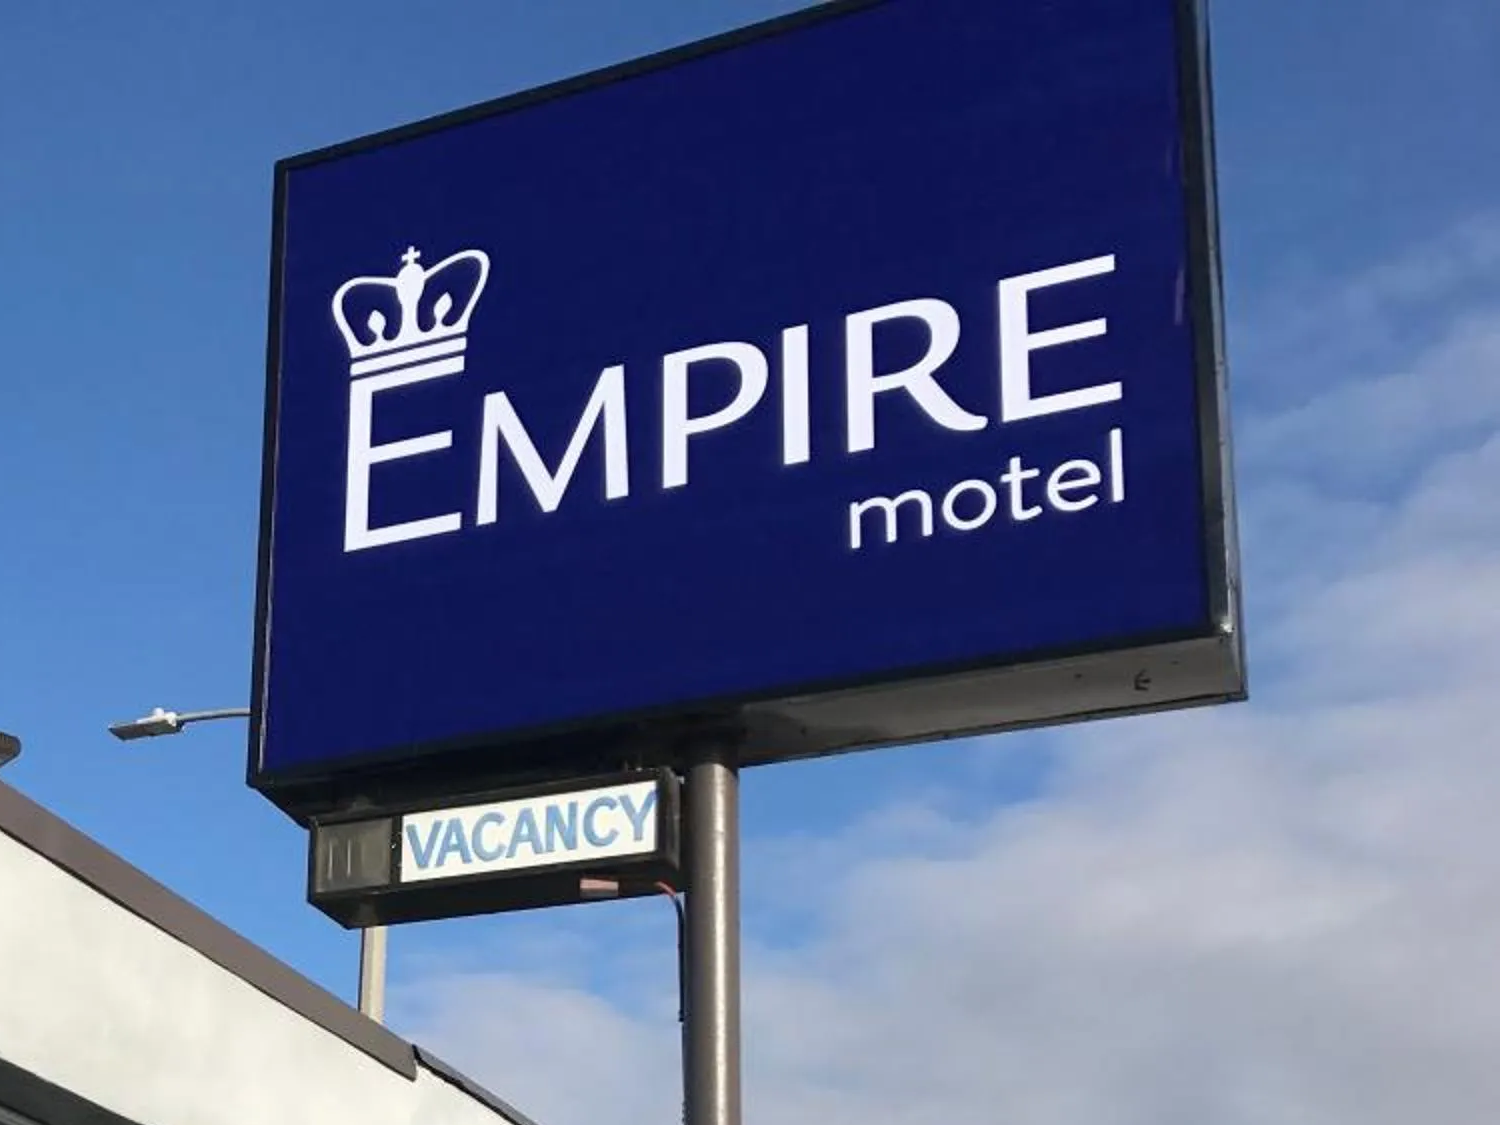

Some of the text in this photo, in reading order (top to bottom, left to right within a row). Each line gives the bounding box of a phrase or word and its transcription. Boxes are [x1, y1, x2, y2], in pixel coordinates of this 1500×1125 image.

[343, 254, 1124, 553] EMPIRE
[849, 428, 1125, 549] motel
[406, 788, 657, 870] VACANCY
